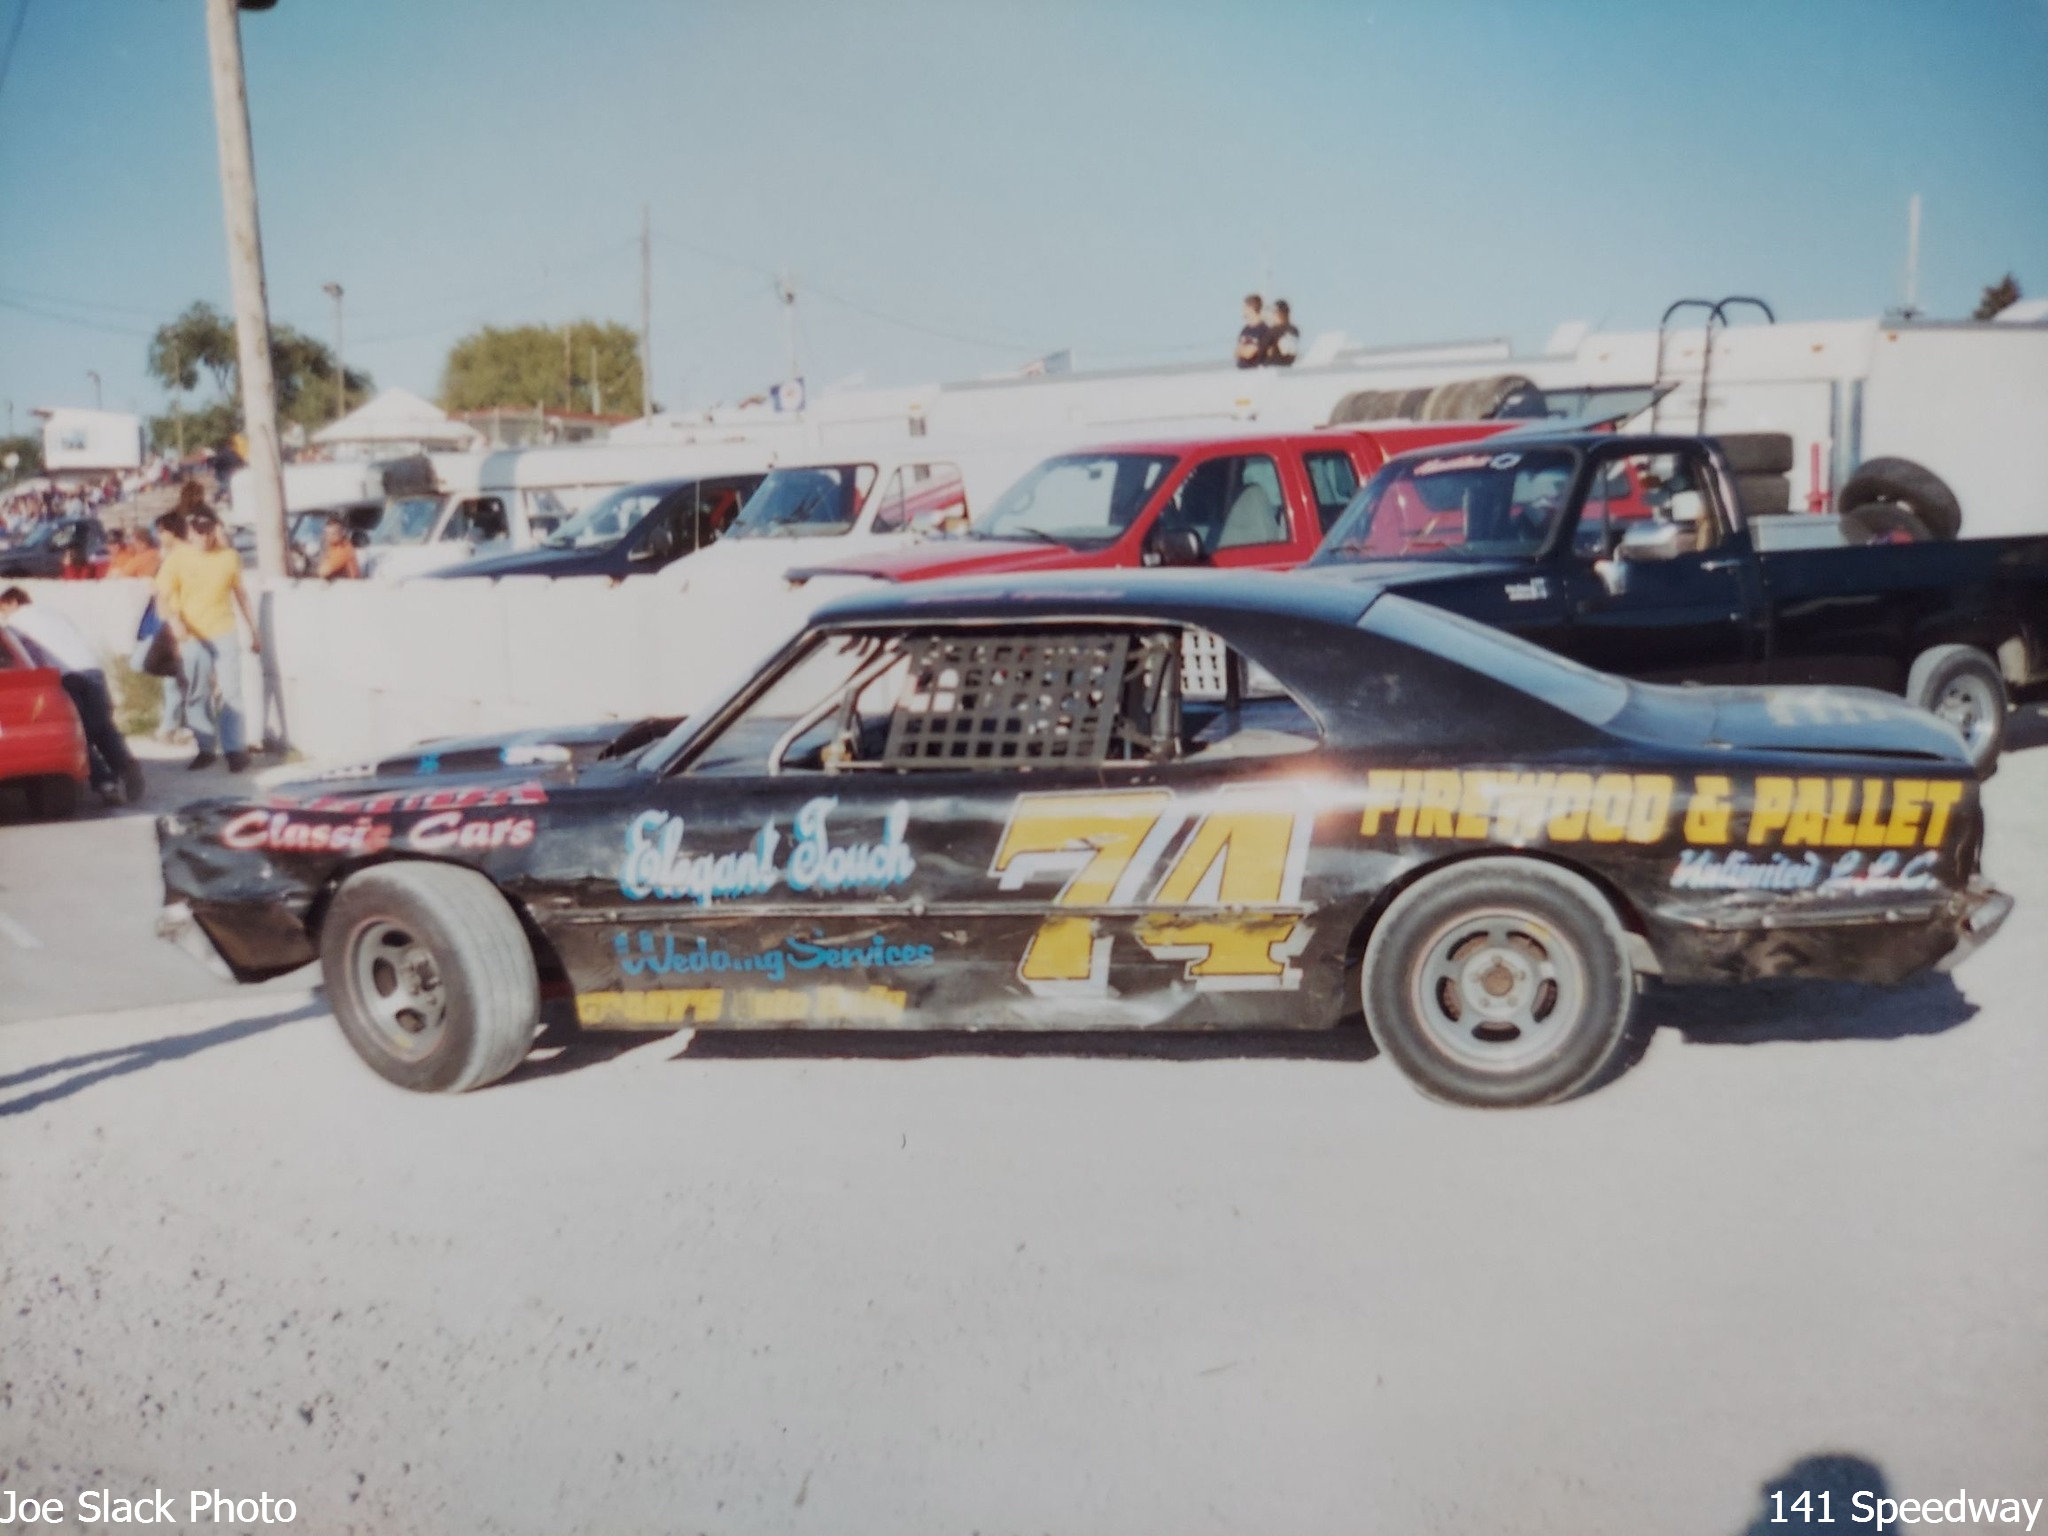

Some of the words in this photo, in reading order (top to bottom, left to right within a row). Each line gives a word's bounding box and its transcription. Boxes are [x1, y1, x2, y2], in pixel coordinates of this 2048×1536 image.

[220, 810, 391, 851] Classic
[408, 813, 536, 850] Cars
[1360, 769, 1674, 844] FIREWOOD
[1684, 774, 1732, 846] &
[1747, 777, 1962, 848] PALLET
[620, 809, 781, 908] Elegant
[787, 795, 916, 892] Touch
[988, 787, 1316, 998] 74
[787, 931, 934, 970] Services
